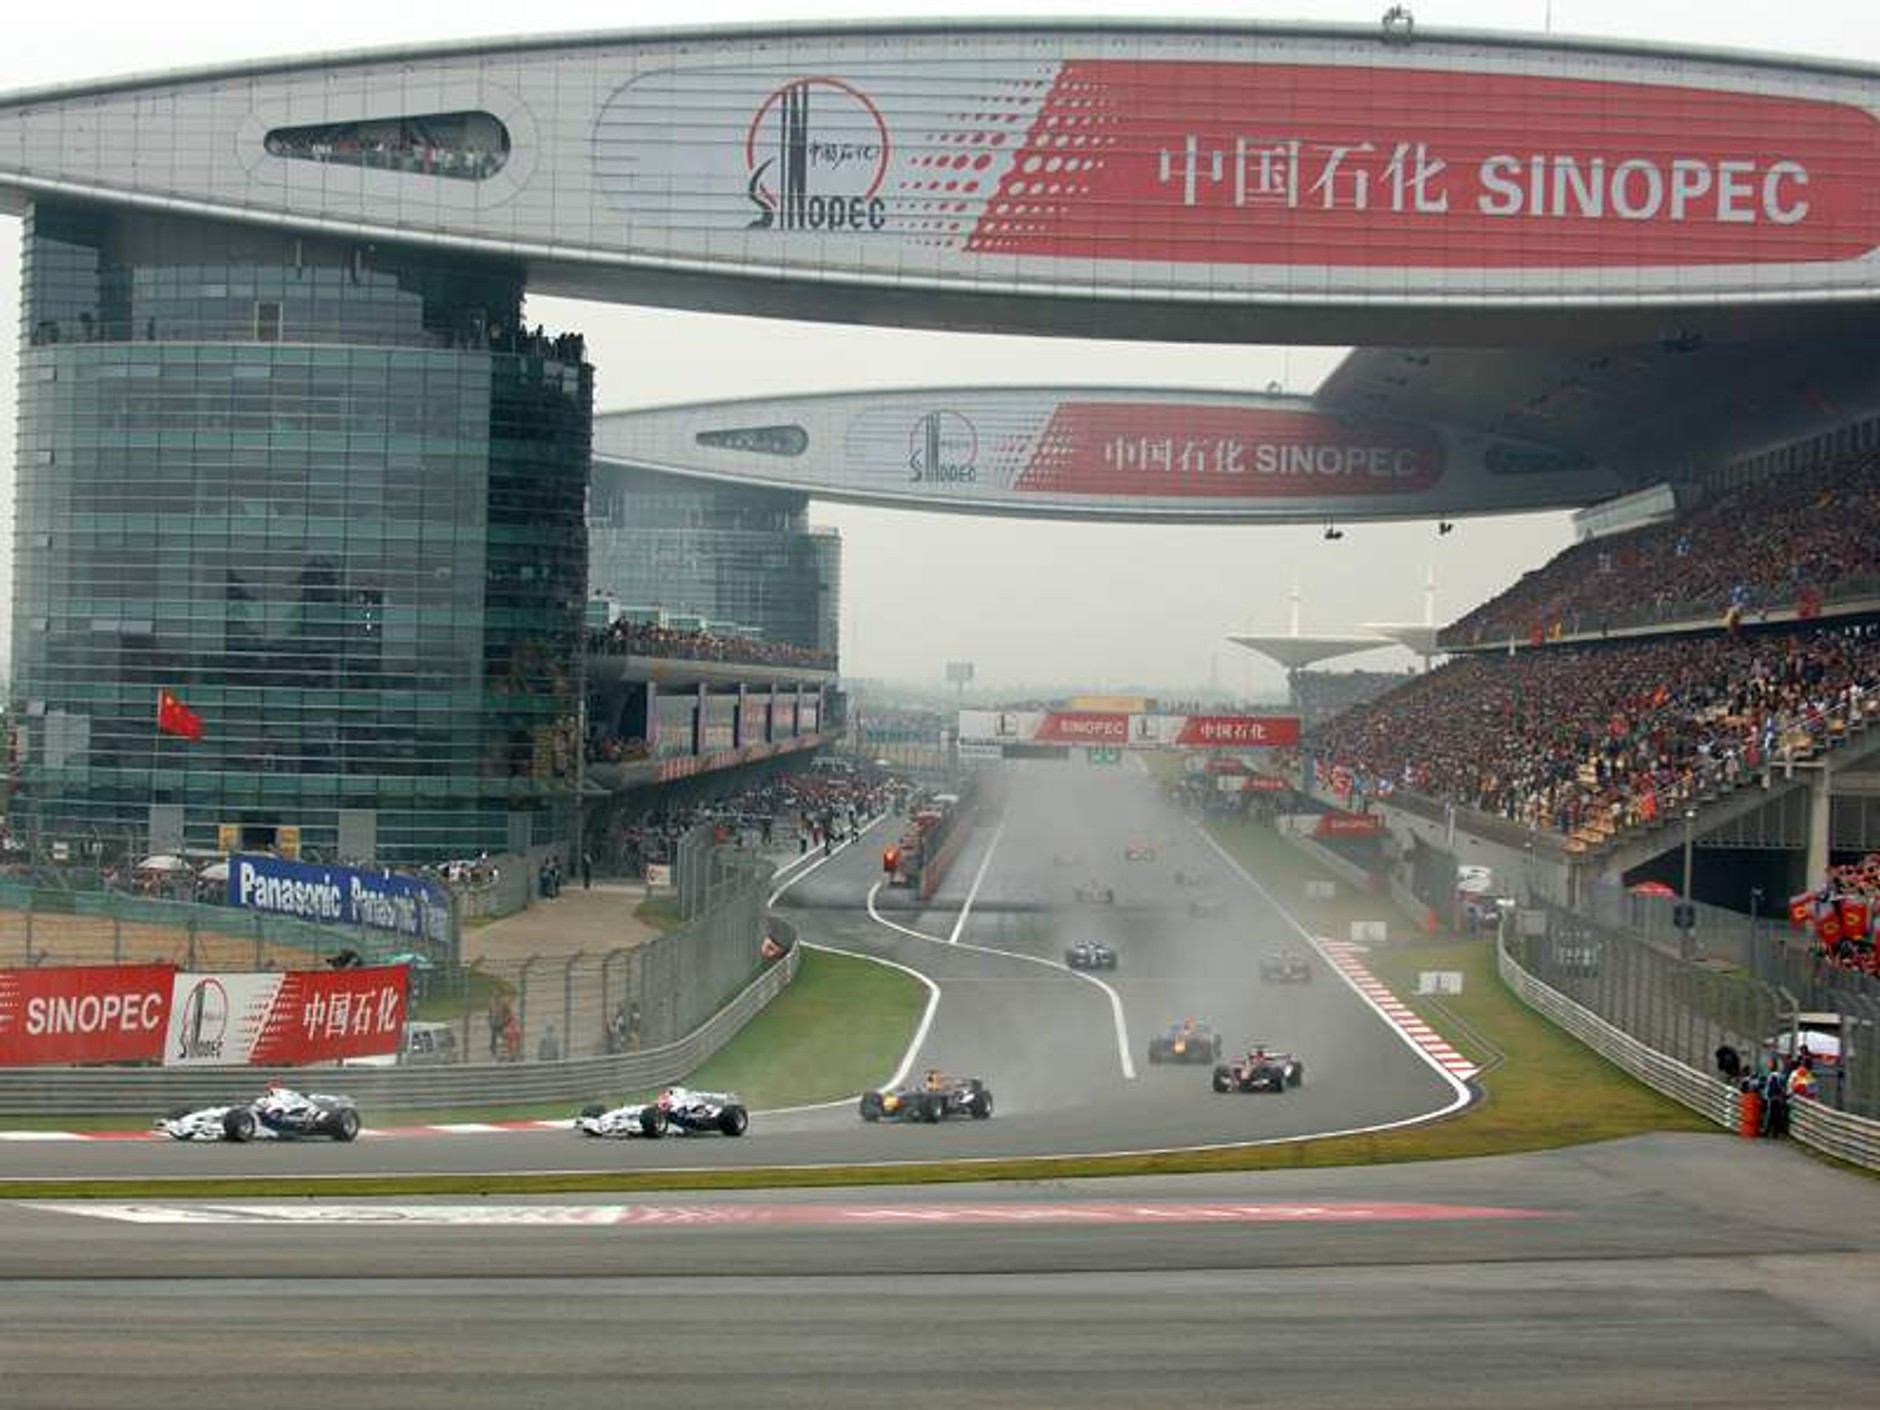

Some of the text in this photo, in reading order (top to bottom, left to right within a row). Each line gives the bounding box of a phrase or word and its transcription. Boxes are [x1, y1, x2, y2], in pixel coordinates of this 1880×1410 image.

[1158, 134, 1811, 226] 中国石化 SINOPEC
[1104, 435, 1418, 477] 中国石化 SINOPEC
[1060, 718, 1126, 736] SINOPEC
[1200, 721, 1267, 740] 中国石化
[239, 862, 342, 918] Panasonic
[26, 992, 163, 1036] SINOPEC
[303, 985, 399, 1040] 中国石化
